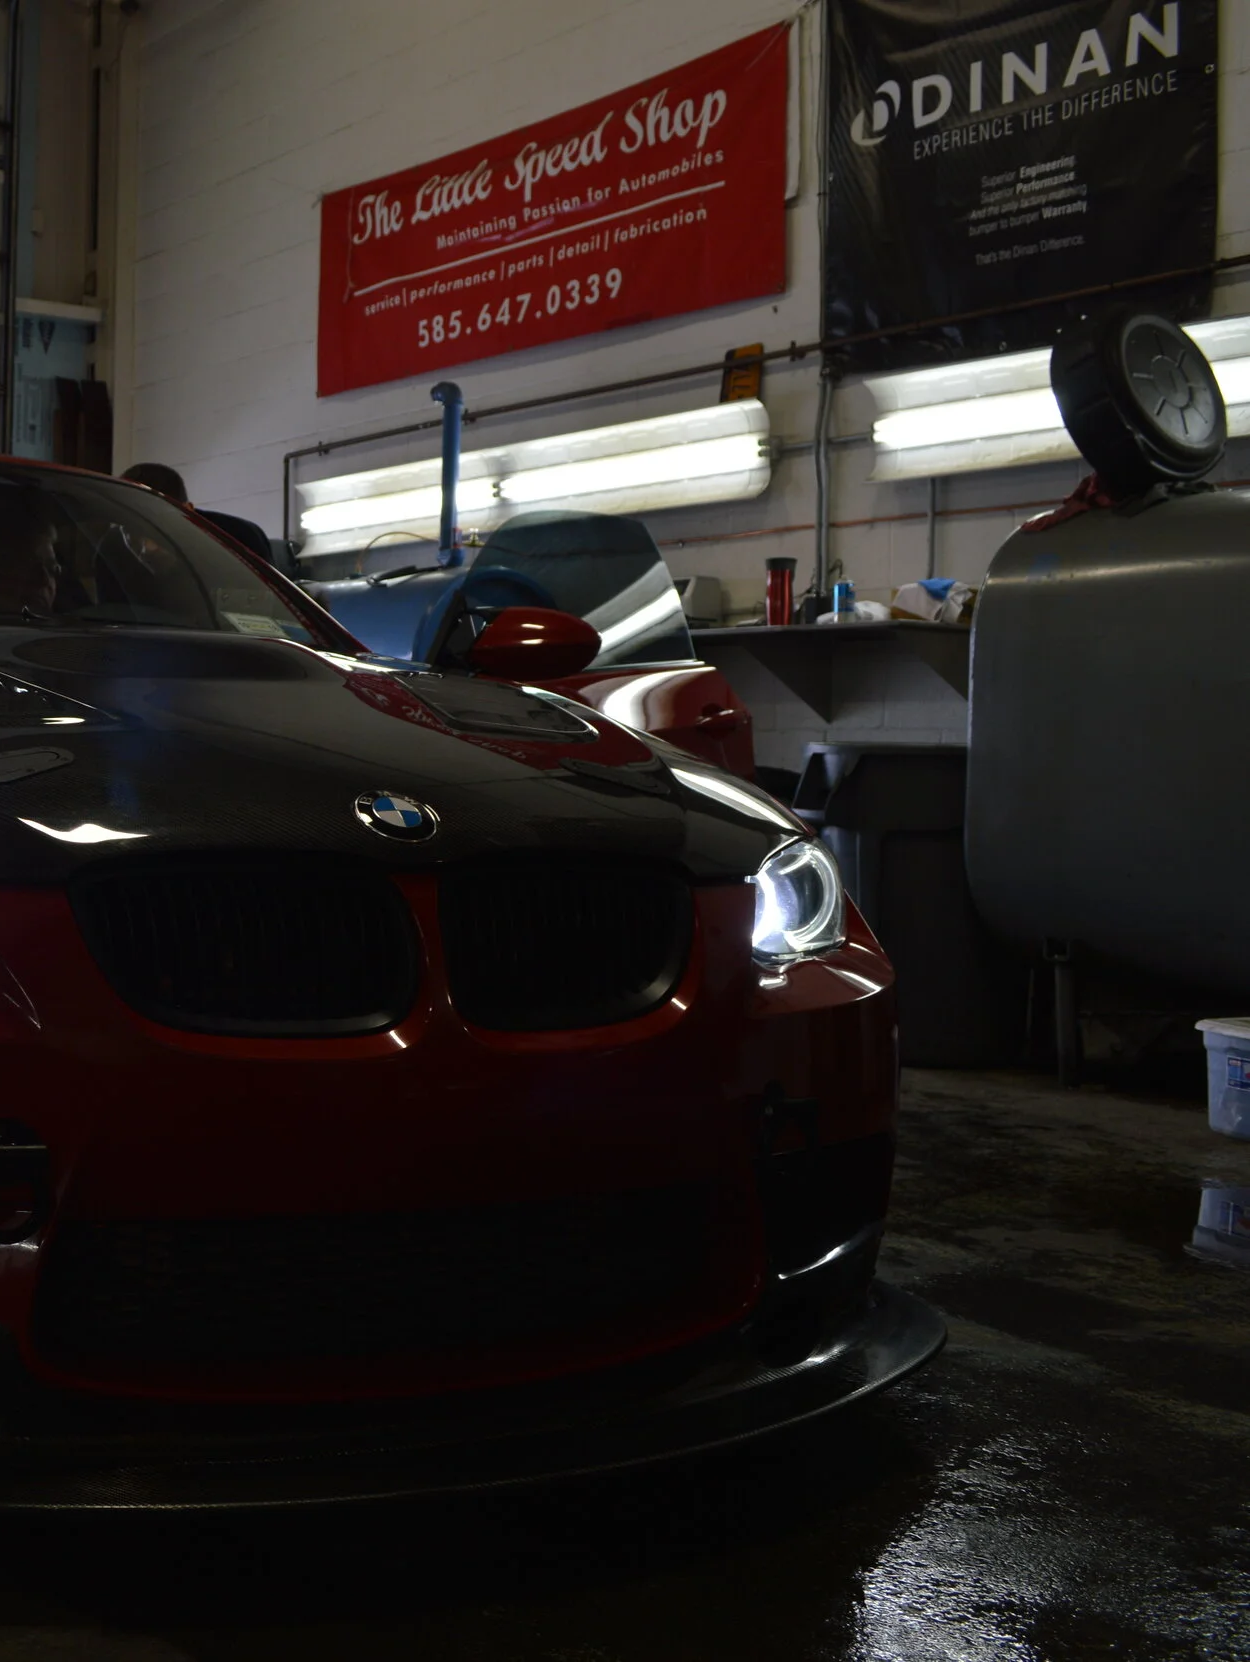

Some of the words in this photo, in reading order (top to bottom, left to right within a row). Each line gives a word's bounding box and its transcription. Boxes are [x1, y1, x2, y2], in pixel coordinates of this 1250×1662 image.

[912, 1, 1178, 129] DINAN
[913, 114, 1014, 160] EXPERIENCE
[1021, 103, 1054, 131] THE
[1061, 69, 1178, 120] DIFFERENCE
[353, 190, 404, 245] The
[411, 158, 493, 225] Little
[504, 110, 614, 203] Speed
[619, 87, 727, 153] Shop
[436, 214, 517, 250] Maintaining
[522, 195, 581, 222] Passion
[587, 186, 611, 202] for
[618, 149, 724, 195] Automobiles
[364, 293, 401, 317] service
[410, 268, 496, 303] performance
[507, 254, 545, 279] parts
[556, 231, 600, 262] detail
[613, 207, 707, 244] fabrication
[418, 267, 622, 348] 585.647.0339
